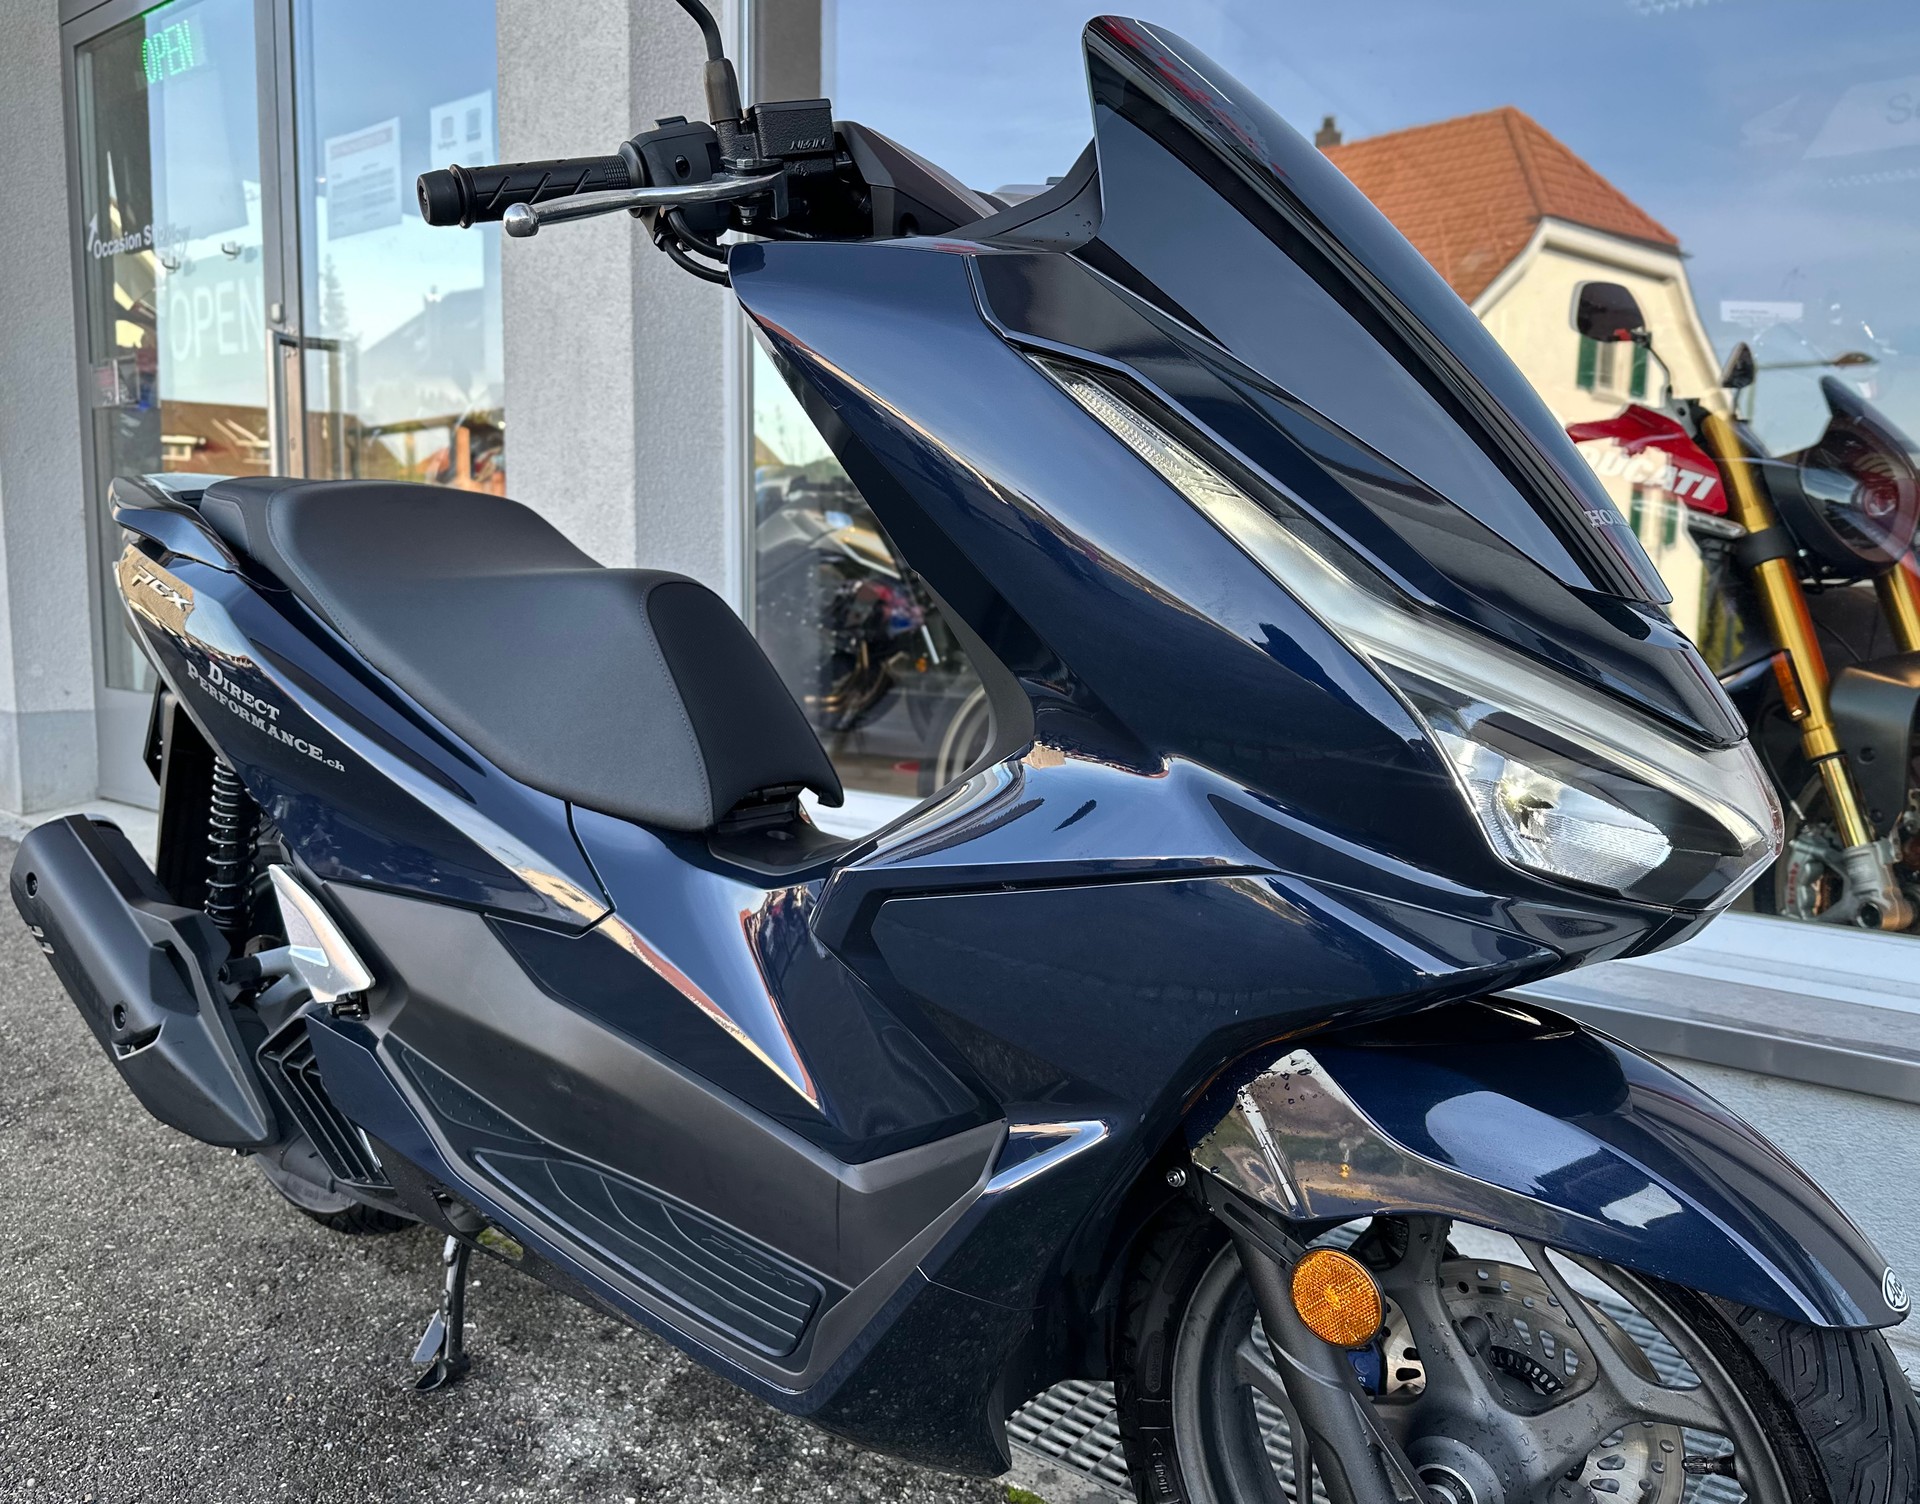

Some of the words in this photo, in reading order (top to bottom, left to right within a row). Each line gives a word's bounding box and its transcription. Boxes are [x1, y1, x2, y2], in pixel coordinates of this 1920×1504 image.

[142, 20, 194, 84] OPEN
[93, 232, 142, 259] Occasion
[170, 276, 264, 361] OPEN
[1584, 509, 1627, 529] HON
[131, 563, 195, 612] PCX
